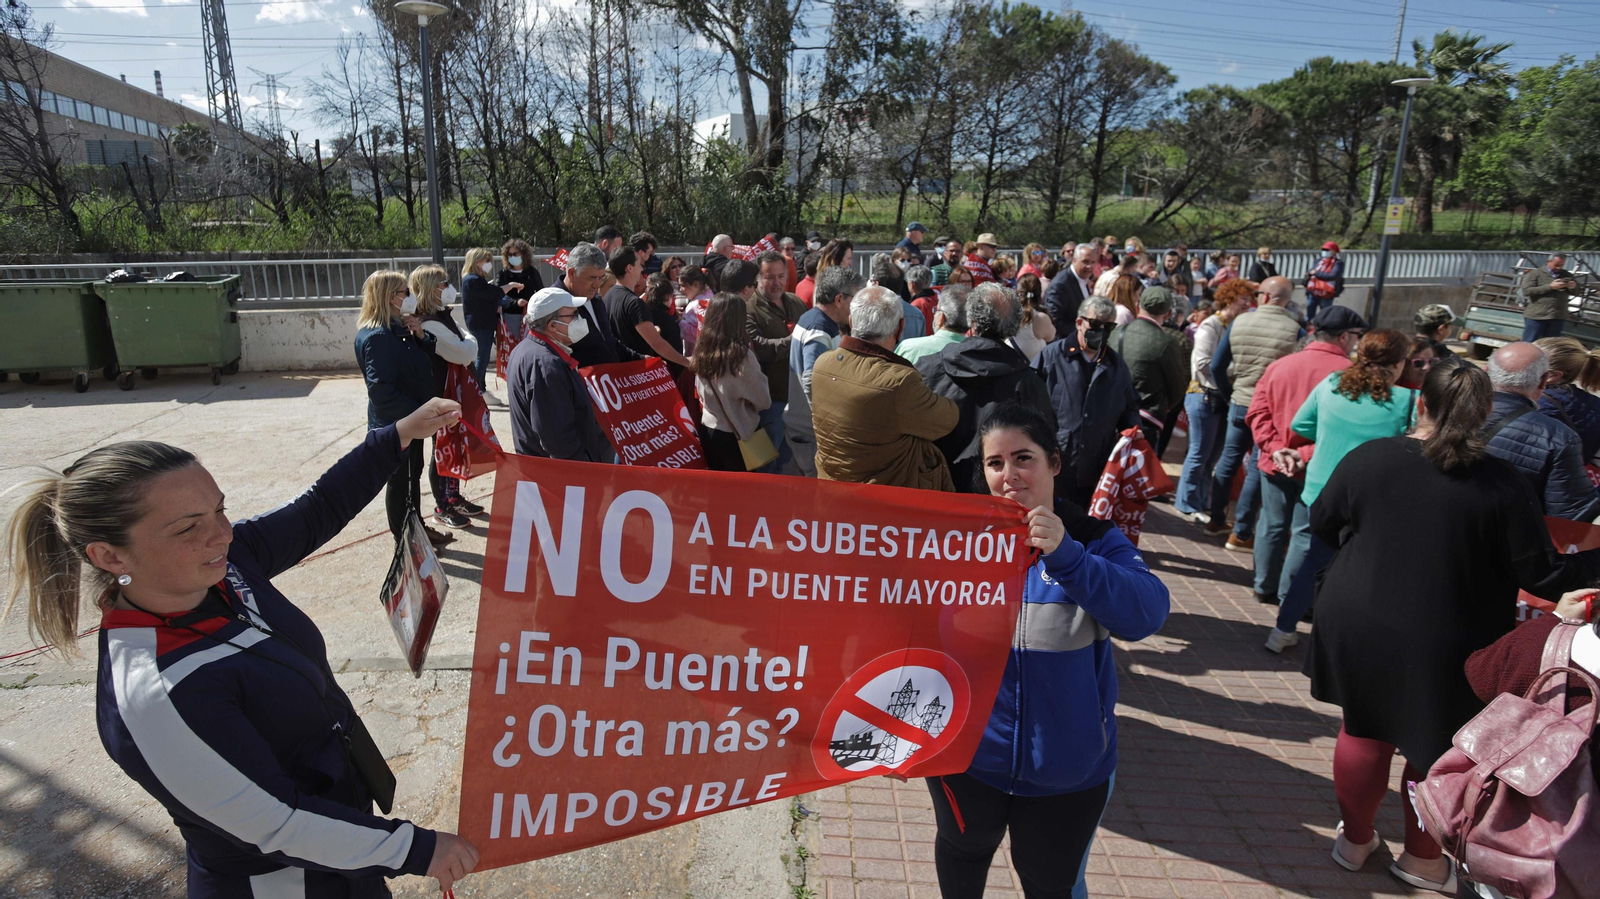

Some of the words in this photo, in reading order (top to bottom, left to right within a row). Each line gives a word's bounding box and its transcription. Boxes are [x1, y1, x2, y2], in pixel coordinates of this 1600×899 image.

[584, 373, 622, 413] NO
[614, 378, 623, 389] A
[620, 376, 631, 388] LA
[623, 393, 633, 404] EN
[633, 388, 659, 402] PUENTE
[621, 409, 668, 438] Puente!
[650, 425, 683, 450] más?
[503, 480, 676, 603] NO
[688, 511, 714, 546] A
[728, 514, 774, 550] LA
[786, 518, 1017, 564] SUBESTACIÓN
[689, 563, 733, 596] EN
[747, 567, 869, 604] PUENTE
[879, 576, 1007, 607] MAYORGA
[494, 630, 583, 695] ¡En
[603, 636, 810, 693] Puente!
[492, 704, 646, 768] ¿Otra
[664, 706, 800, 757] más?
[489, 772, 788, 840] IMPOSIBLE
